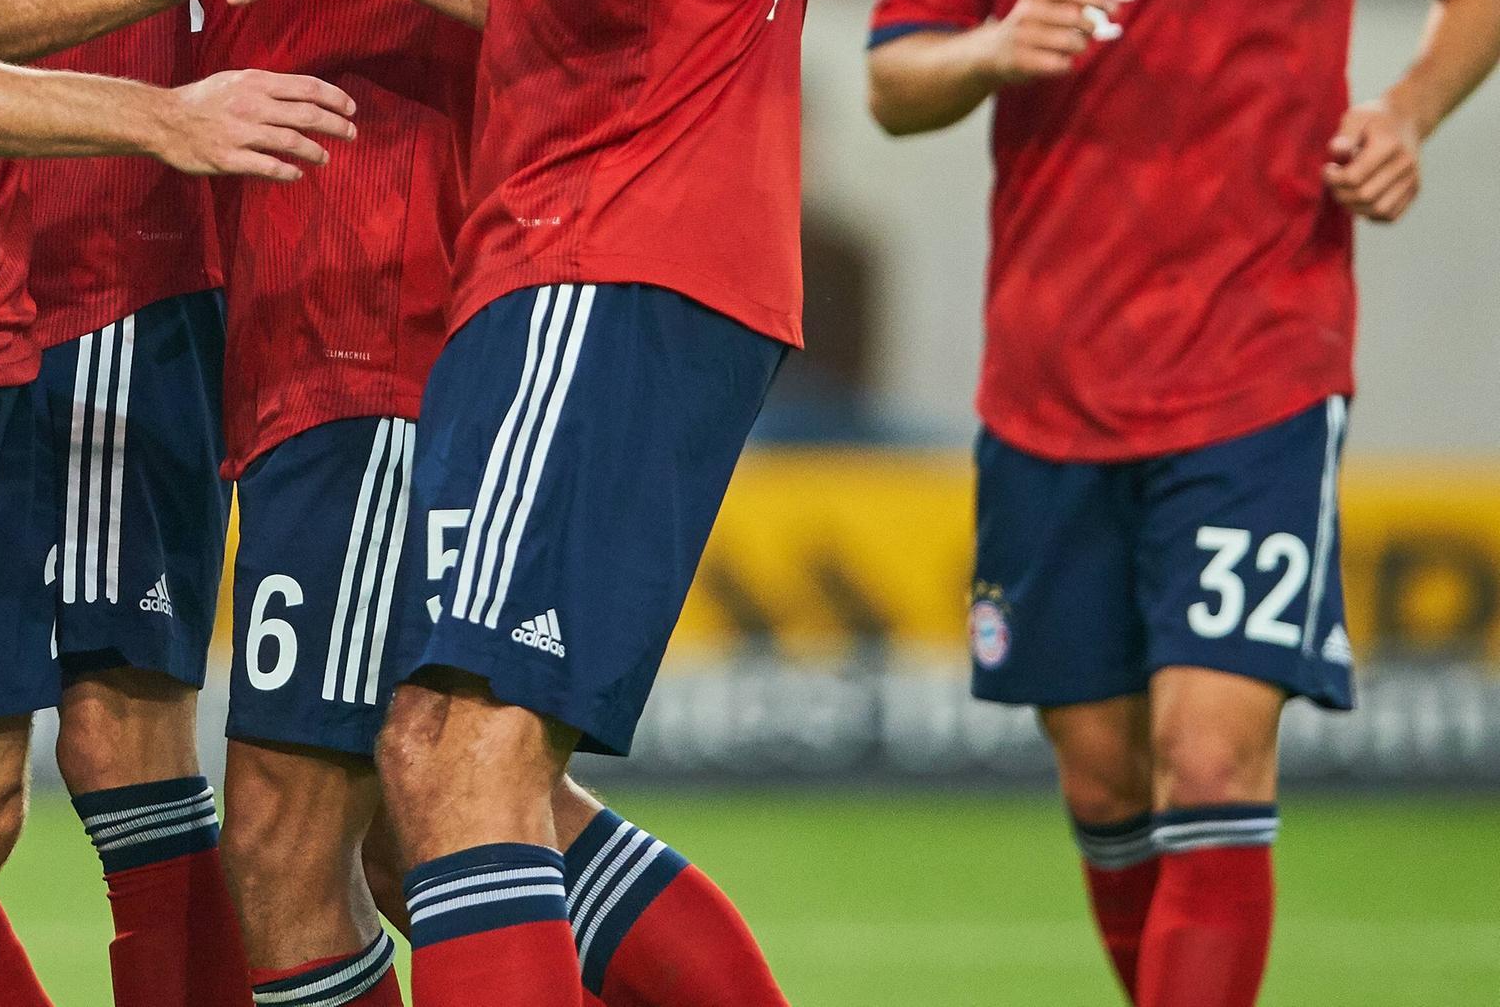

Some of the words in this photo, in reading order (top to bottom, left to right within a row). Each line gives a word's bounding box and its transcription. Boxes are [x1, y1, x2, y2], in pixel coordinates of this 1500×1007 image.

[245, 574, 303, 691] 6
[511, 628, 566, 658] adidas
[1187, 525, 1311, 648] 32
